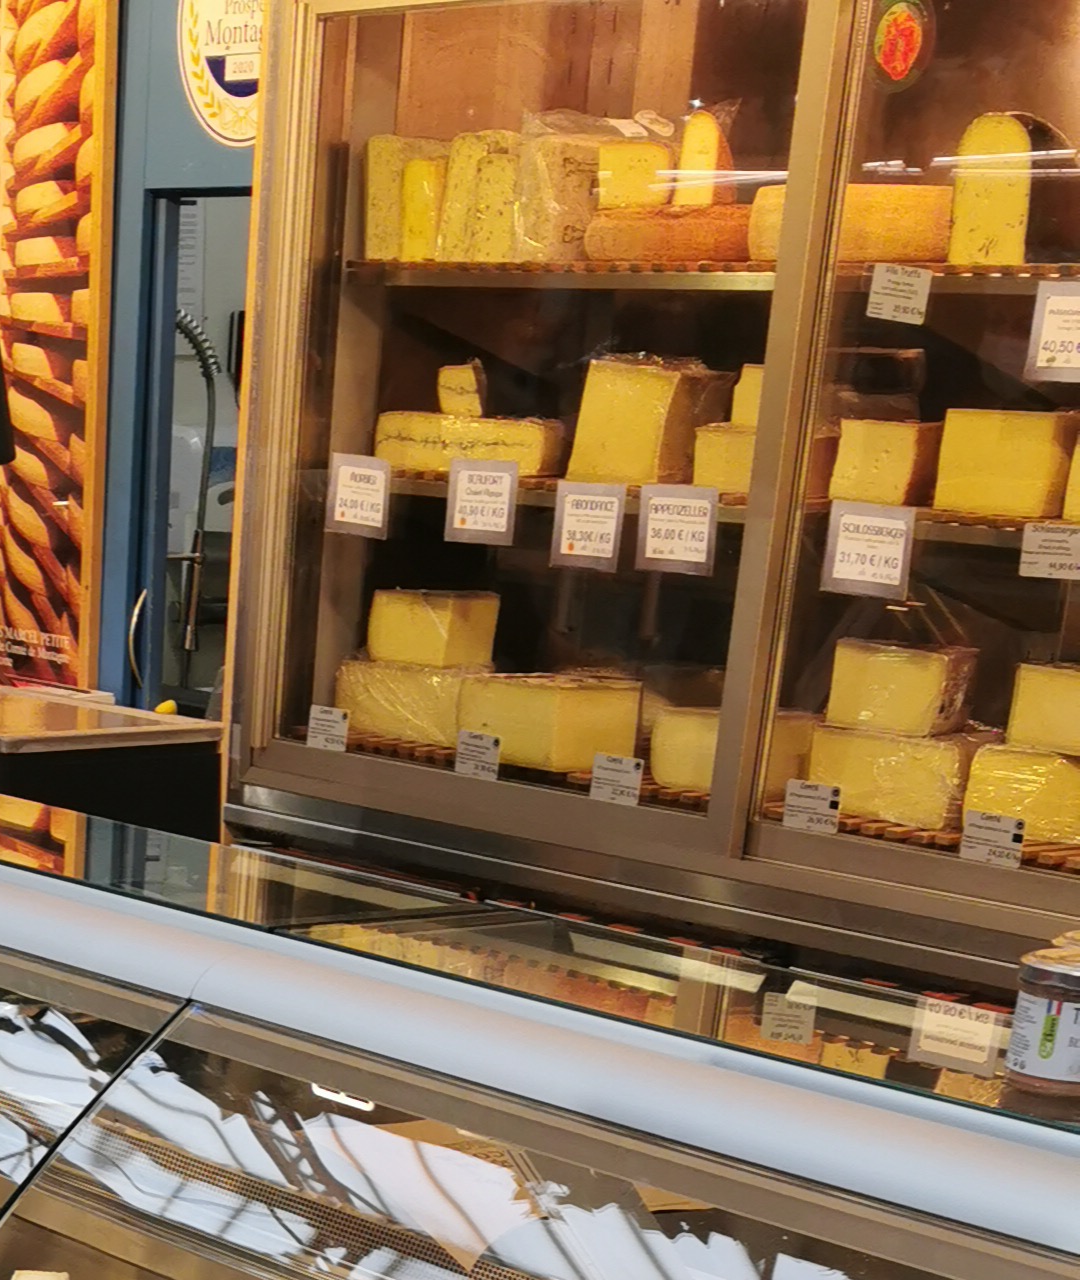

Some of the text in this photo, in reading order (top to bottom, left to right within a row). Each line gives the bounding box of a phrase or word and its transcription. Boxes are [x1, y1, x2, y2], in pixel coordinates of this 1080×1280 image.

[1041, 340, 1074, 355] 40,50
[467, 473, 503, 487] BEAUFORT
[571, 499, 615, 513] ABONDANCE
[649, 503, 709, 518] APPENZELLER
[841, 522, 905, 538] SCHLOSSBERGER
[838, 551, 867, 566] 31,70
